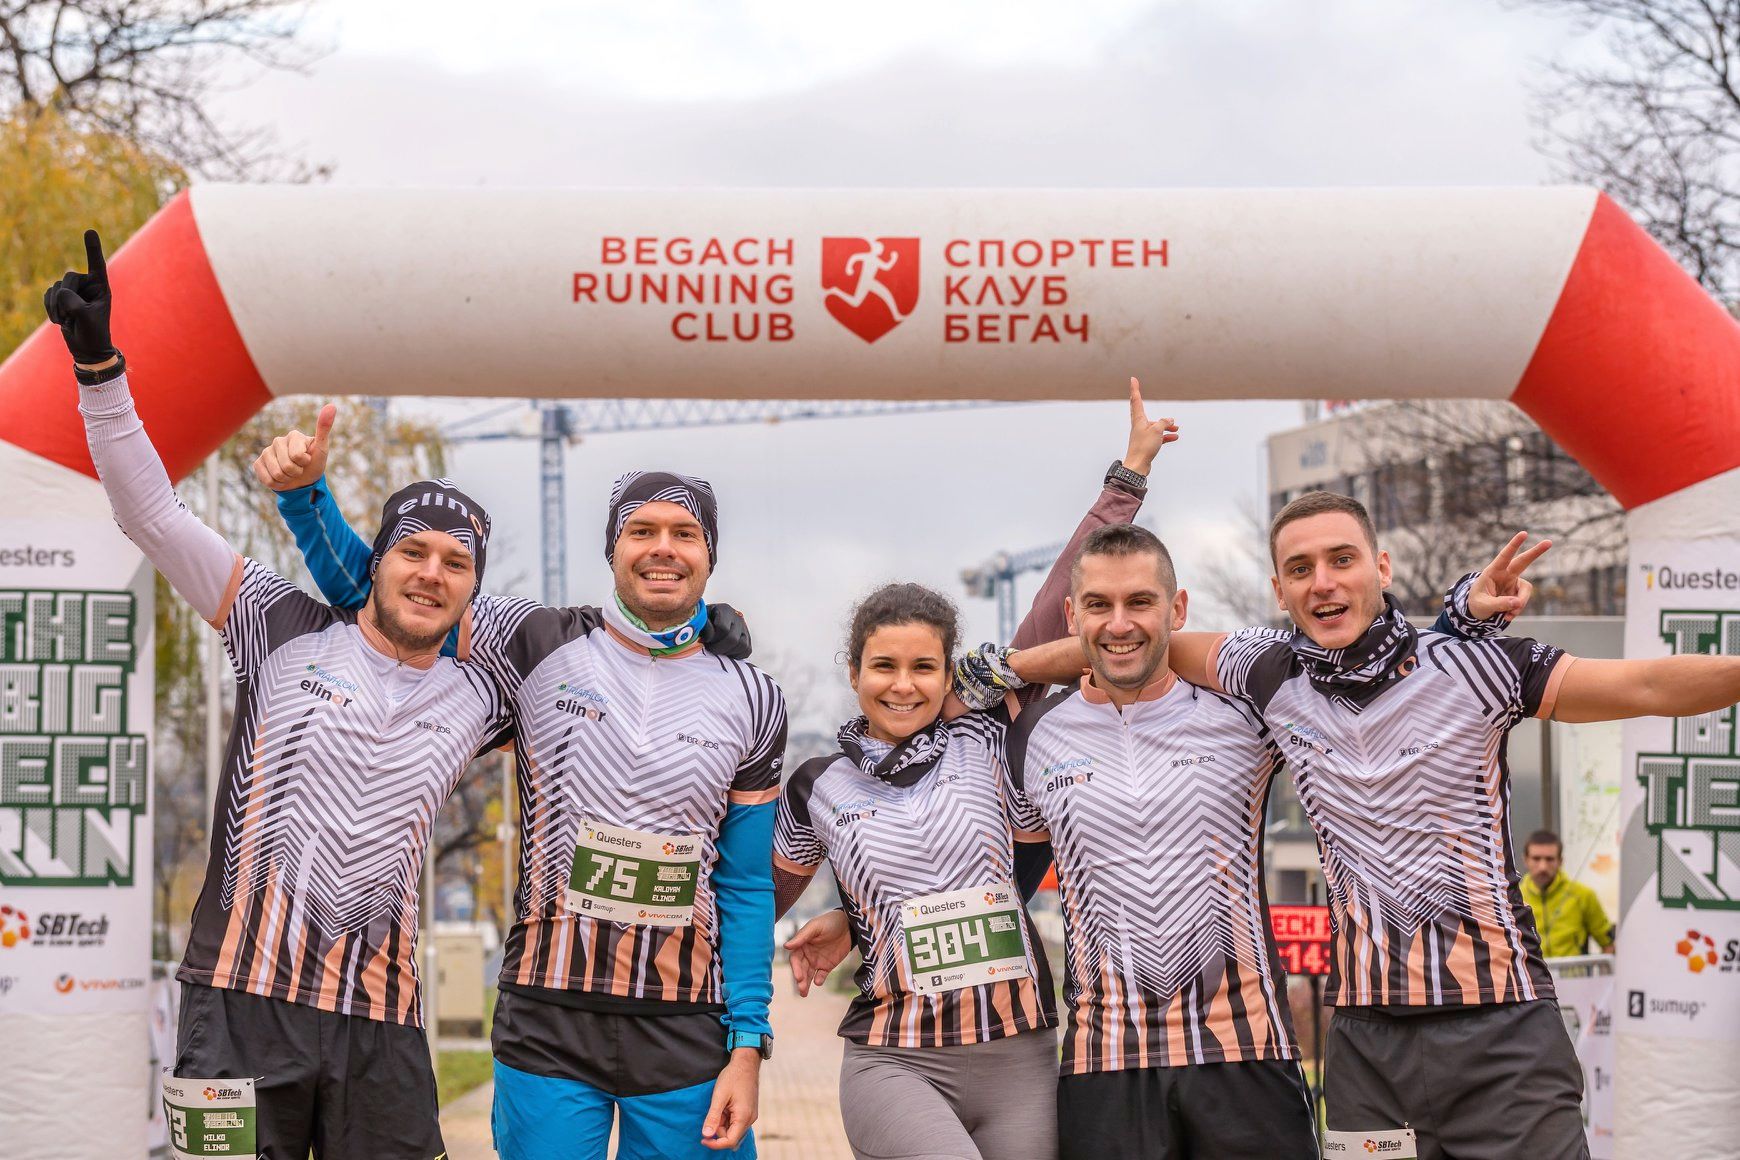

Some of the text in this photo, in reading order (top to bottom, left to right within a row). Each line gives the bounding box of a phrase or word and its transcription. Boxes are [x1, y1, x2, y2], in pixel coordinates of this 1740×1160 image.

[601, 236, 796, 266] BEGACH
[943, 238, 1169, 269] СПОРТЕН
[572, 272, 796, 305] RUNNING
[944, 275, 1069, 307] КЛУБ
[671, 311, 796, 342] CLUB
[944, 313, 1089, 344] БЕГАЧ
[0, 546, 75, 567] esters
[1658, 565, 1740, 591] Queste
[300, 679, 352, 708] elinor
[555, 698, 607, 722] elinor
[1046, 771, 1094, 792] elinor
[836, 809, 878, 827] elinor
[596, 831, 642, 849] Questers
[585, 853, 640, 899] 75
[920, 900, 966, 915] Questers
[36, 913, 110, 938] SBTech
[910, 918, 989, 969] 304
[1650, 1000, 1700, 1020] sumup
[217, 1088, 242, 1097] SBTech
[203, 1133, 226, 1141] MILKO
[203, 1143, 230, 1151] ELINOR
[1377, 1139, 1402, 1149] SBTech
